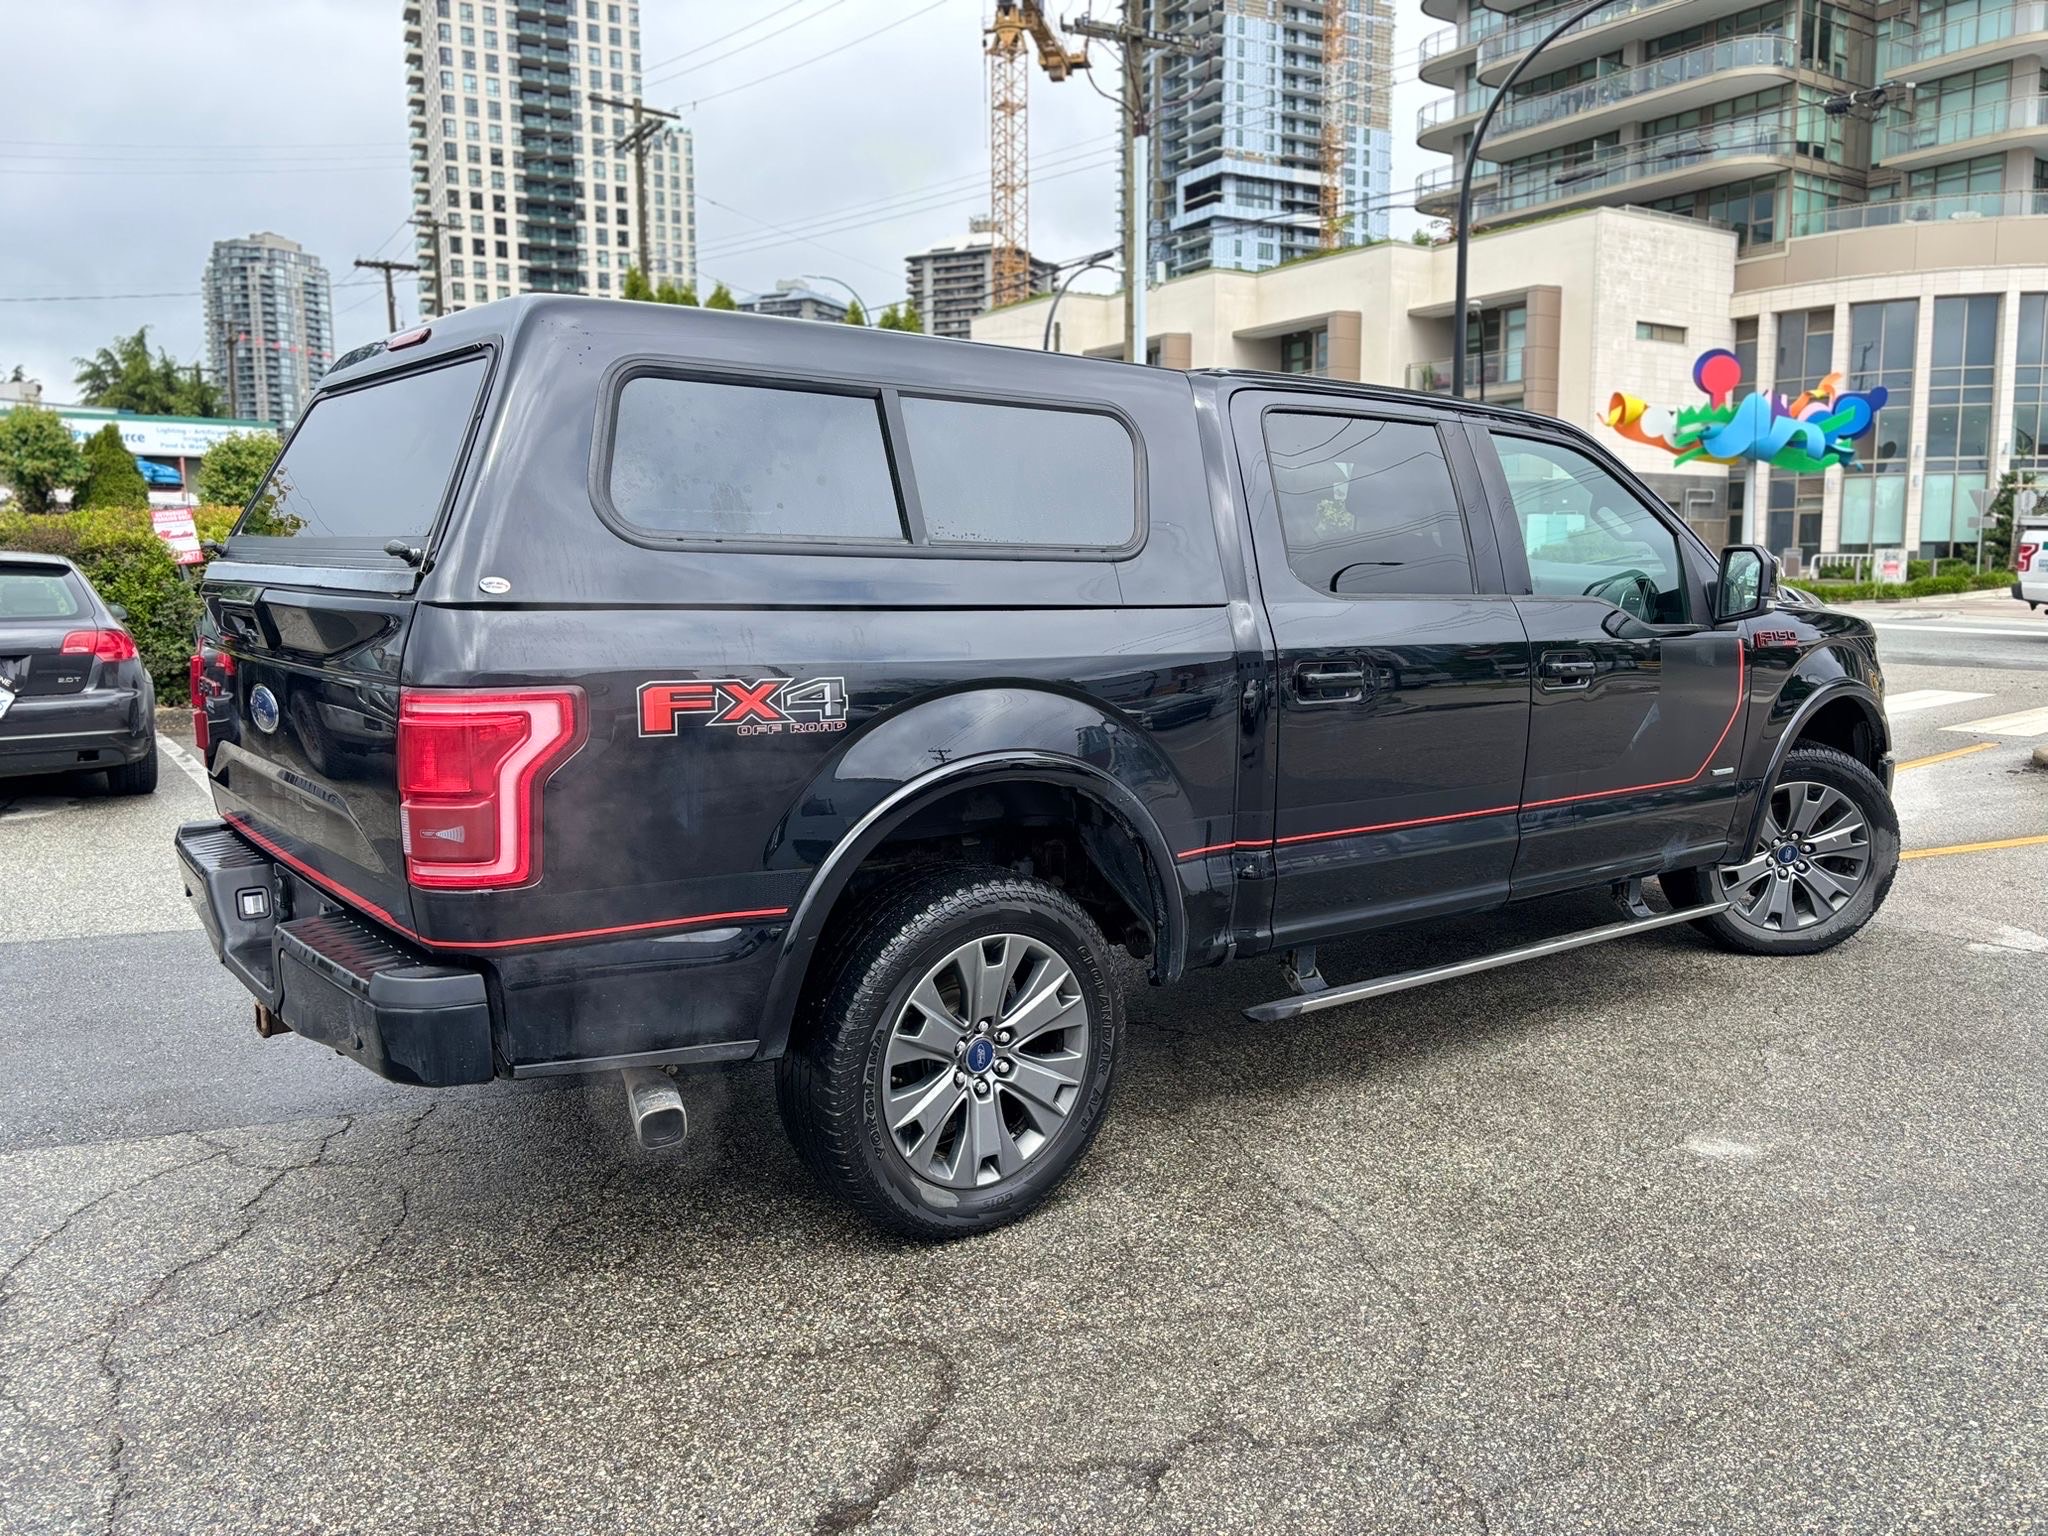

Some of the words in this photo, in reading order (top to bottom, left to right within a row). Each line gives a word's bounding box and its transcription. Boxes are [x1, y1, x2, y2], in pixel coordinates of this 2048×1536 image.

[637, 677, 849, 738] FX4
[737, 724, 783, 736] OFF
[790, 721, 848, 734] ROAD
[862, 1029, 886, 1160] YOKOHAMA
